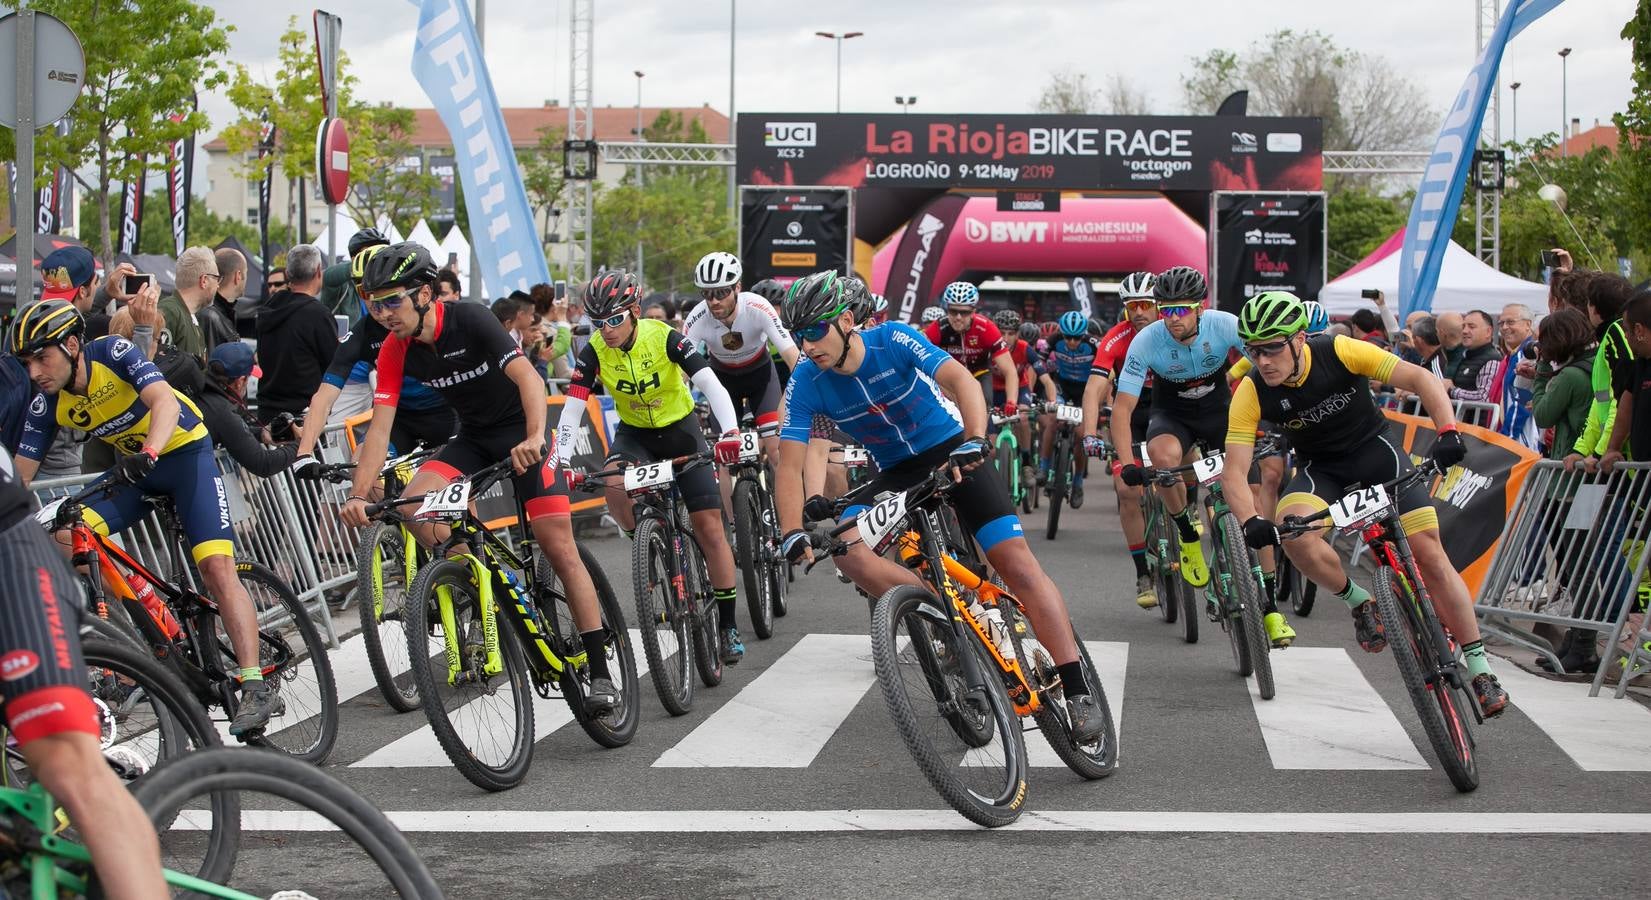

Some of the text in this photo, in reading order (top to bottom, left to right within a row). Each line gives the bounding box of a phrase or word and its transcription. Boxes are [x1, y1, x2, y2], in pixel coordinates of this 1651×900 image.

[775, 127, 812, 142] UCI
[866, 123, 913, 154] La
[1105, 129, 1193, 156] RACE
[777, 149, 804, 159] XCS 2
[866, 160, 951, 179] LOGROÑO
[1022, 165, 1055, 179] 2019
[1131, 159, 1192, 178] octagon
[991, 222, 1048, 243] BWT
[1062, 222, 1148, 234] MAGNESIUM
[898, 231, 938, 324] NDURA
[615, 371, 661, 396] BH
[635, 464, 660, 482] 95
[213, 477, 230, 530] VIKINGS
[1339, 486, 1380, 518] 124
[864, 496, 899, 536] 105
